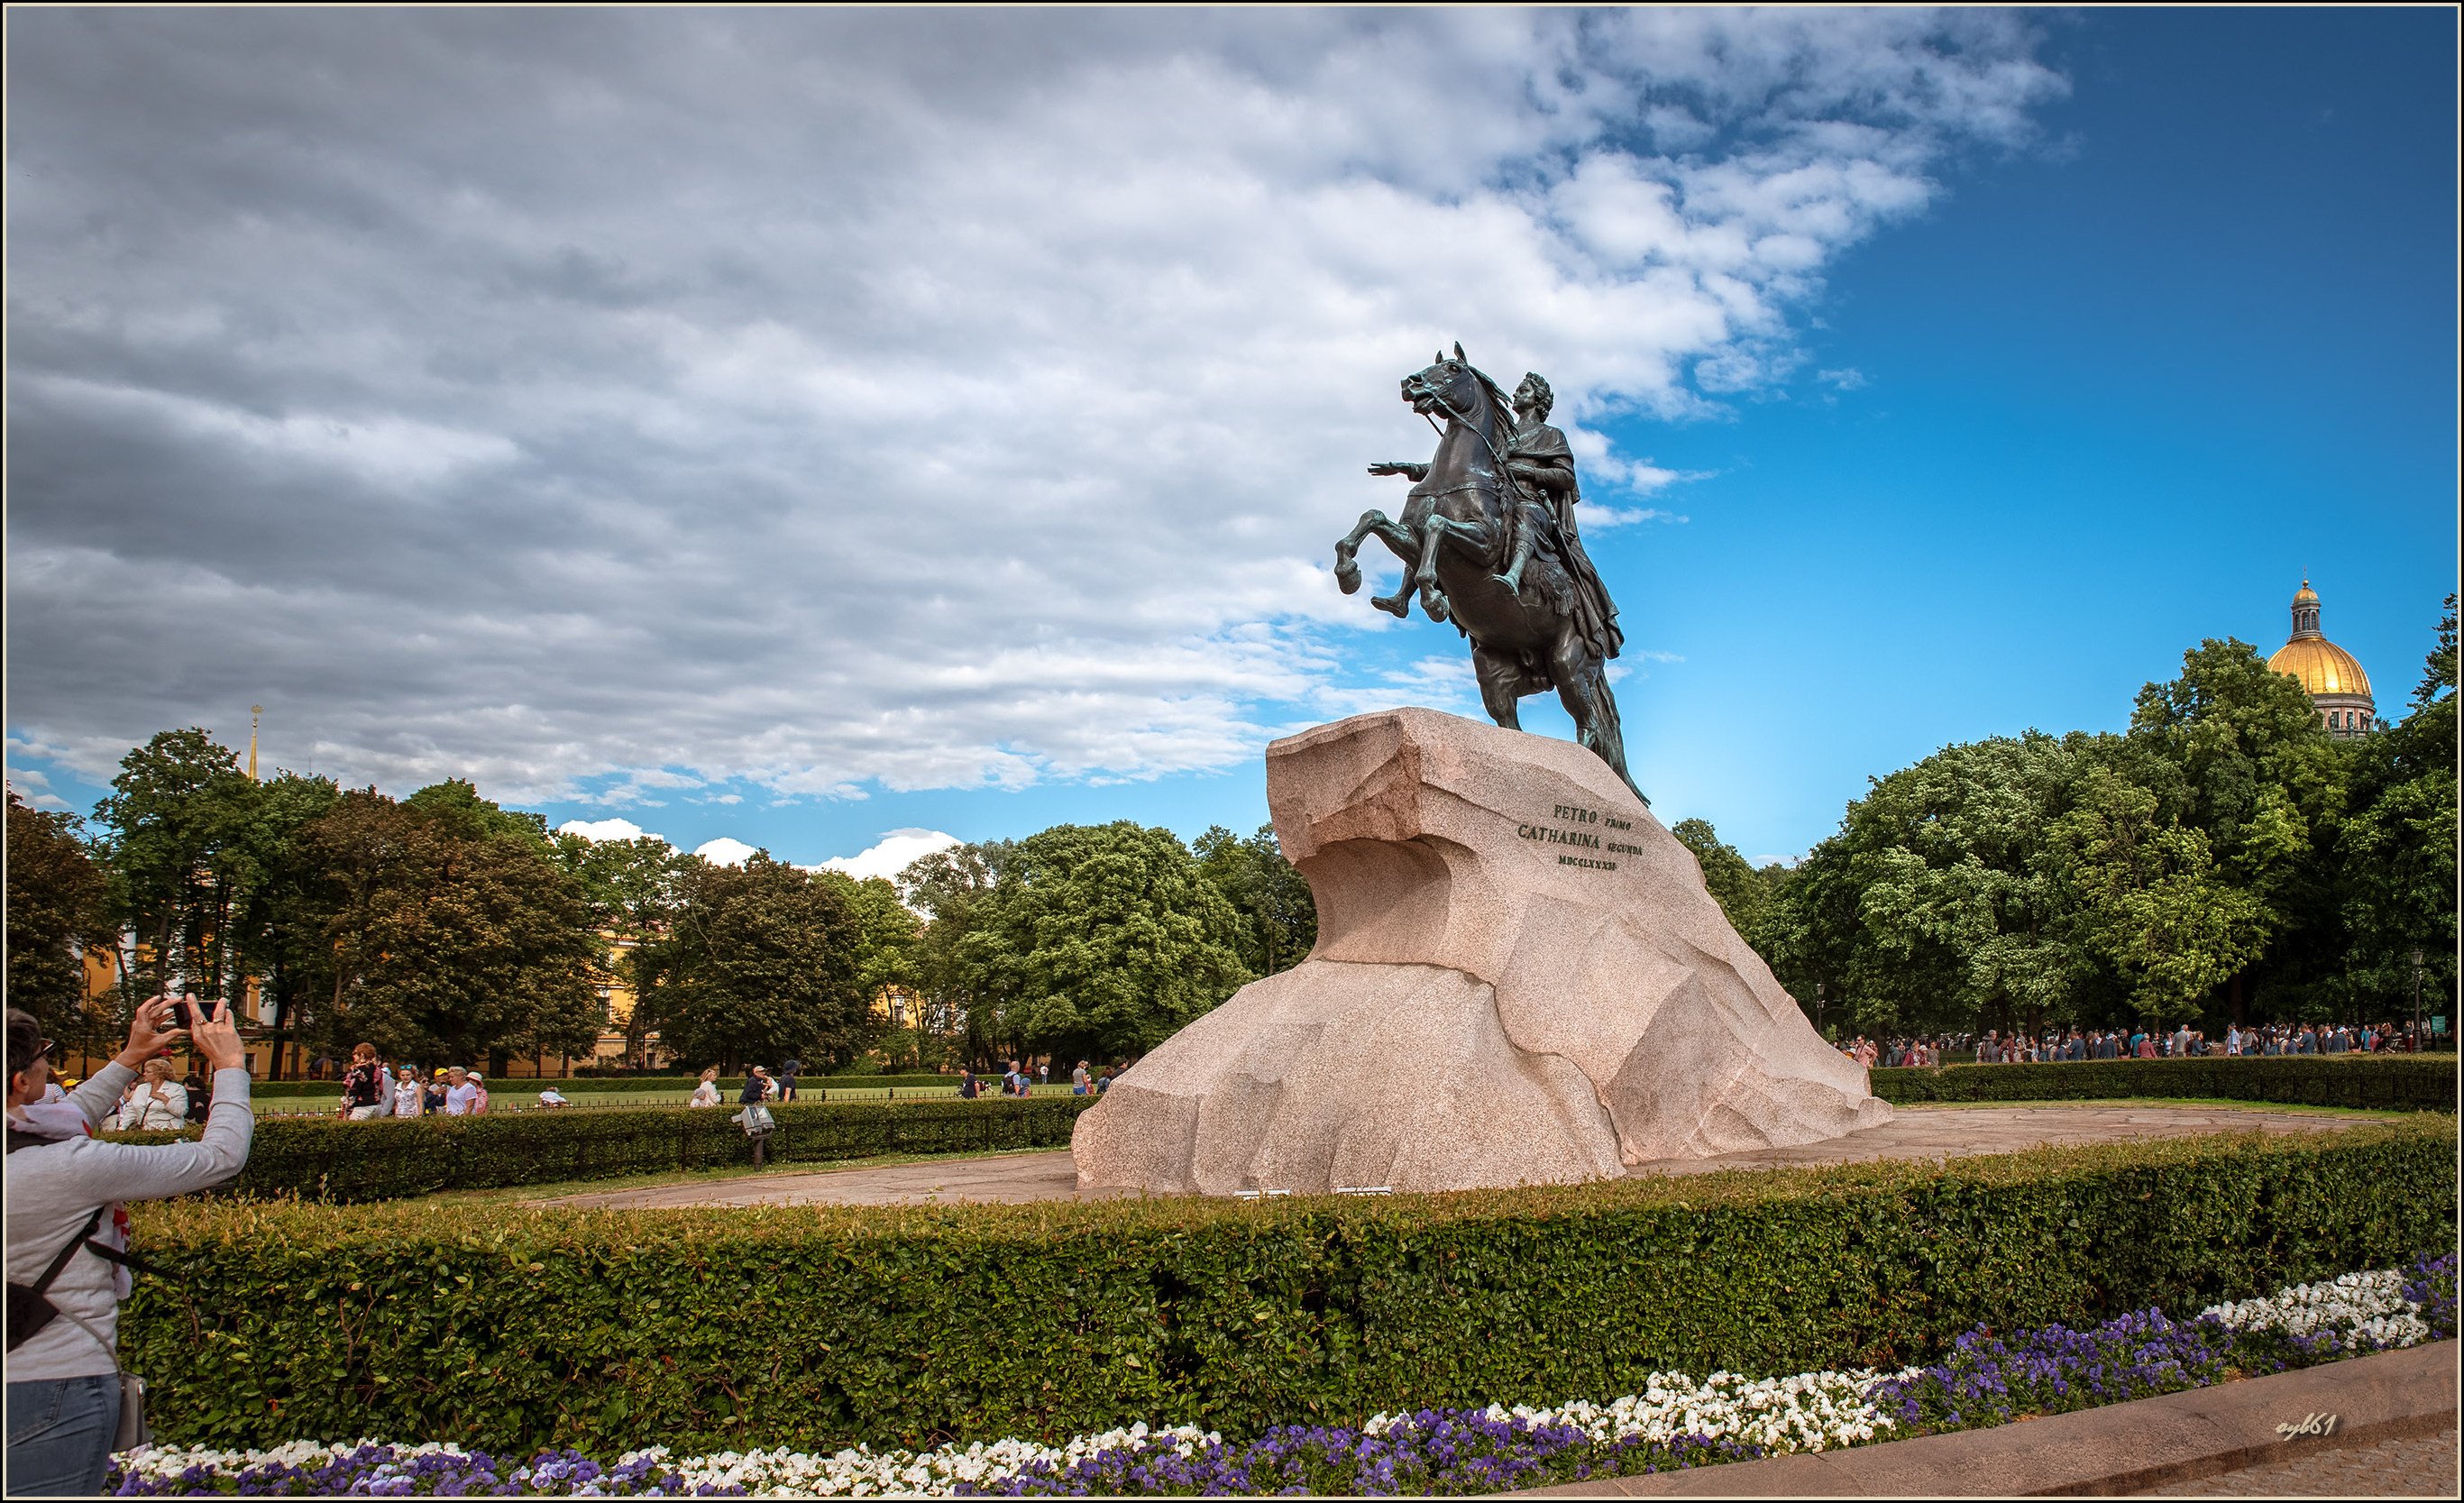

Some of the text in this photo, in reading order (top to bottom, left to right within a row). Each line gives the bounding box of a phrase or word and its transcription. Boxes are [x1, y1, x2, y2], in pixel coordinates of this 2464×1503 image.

[1553, 804, 1631, 830] PETRO PRIMO
[1517, 824, 1643, 856] CATHARINA SECUNDA
